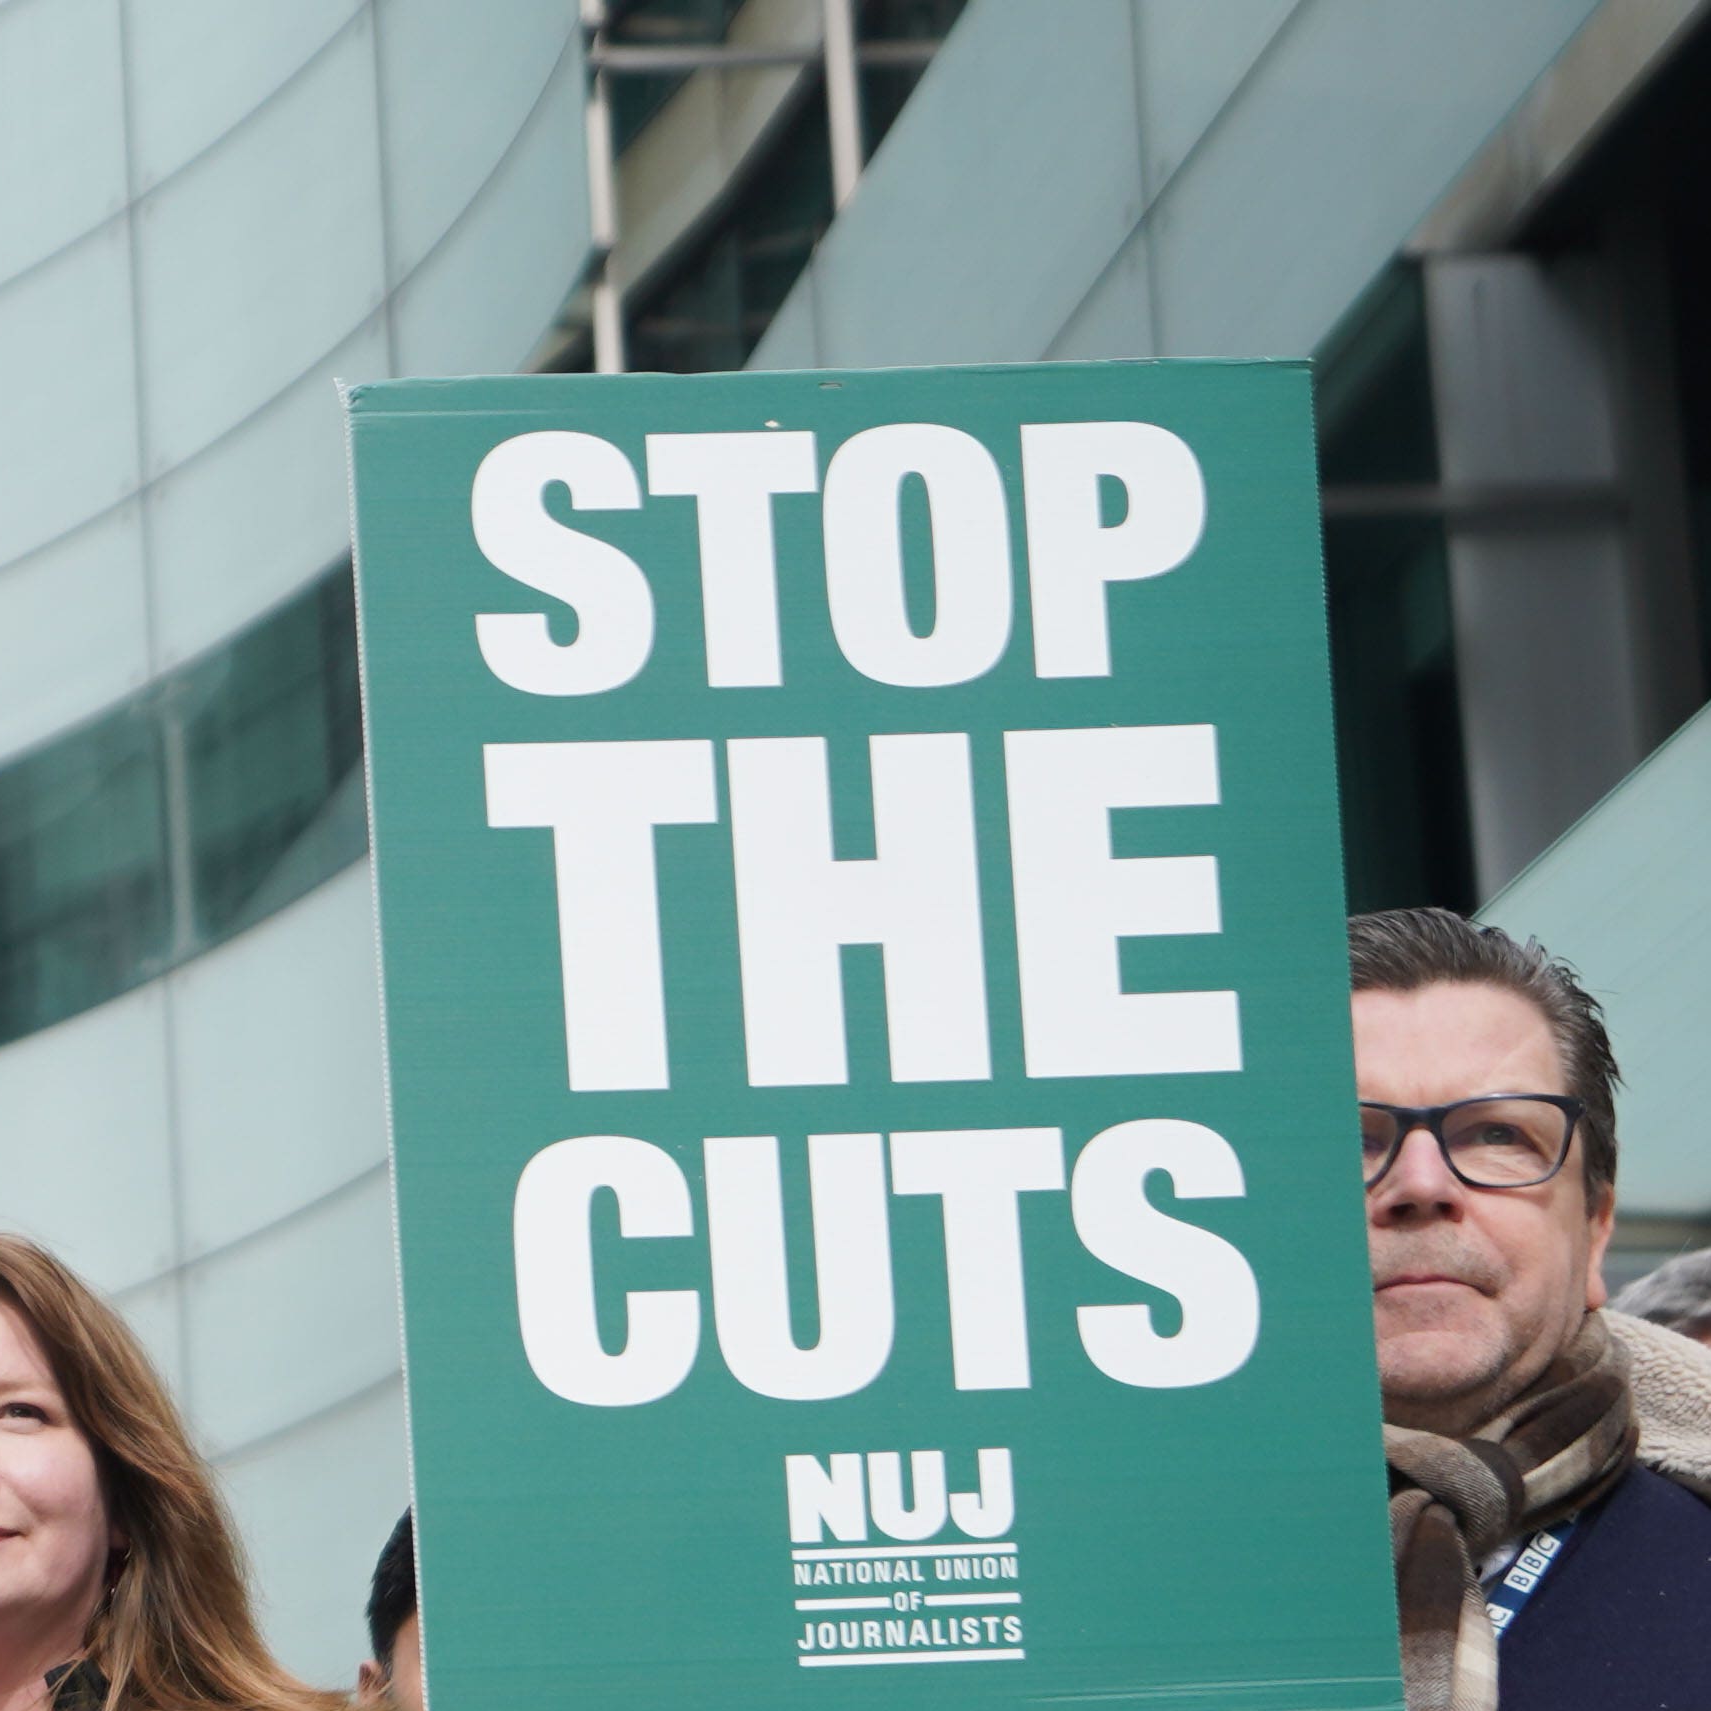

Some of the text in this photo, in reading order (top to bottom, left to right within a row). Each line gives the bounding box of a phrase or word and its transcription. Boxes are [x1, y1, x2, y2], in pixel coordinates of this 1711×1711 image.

[471, 421, 1206, 696] STOP
[482, 724, 1244, 1092] THE
[513, 1119, 1261, 1407] CUTS
[785, 1448, 1015, 1542] NUJ
[794, 1557, 1018, 1585] NATIONAL UNION
[1509, 1533, 1557, 1588] BBC
[798, 1616, 1023, 1650] JOURNALISTS
[893, 1591, 924, 1611] OF
